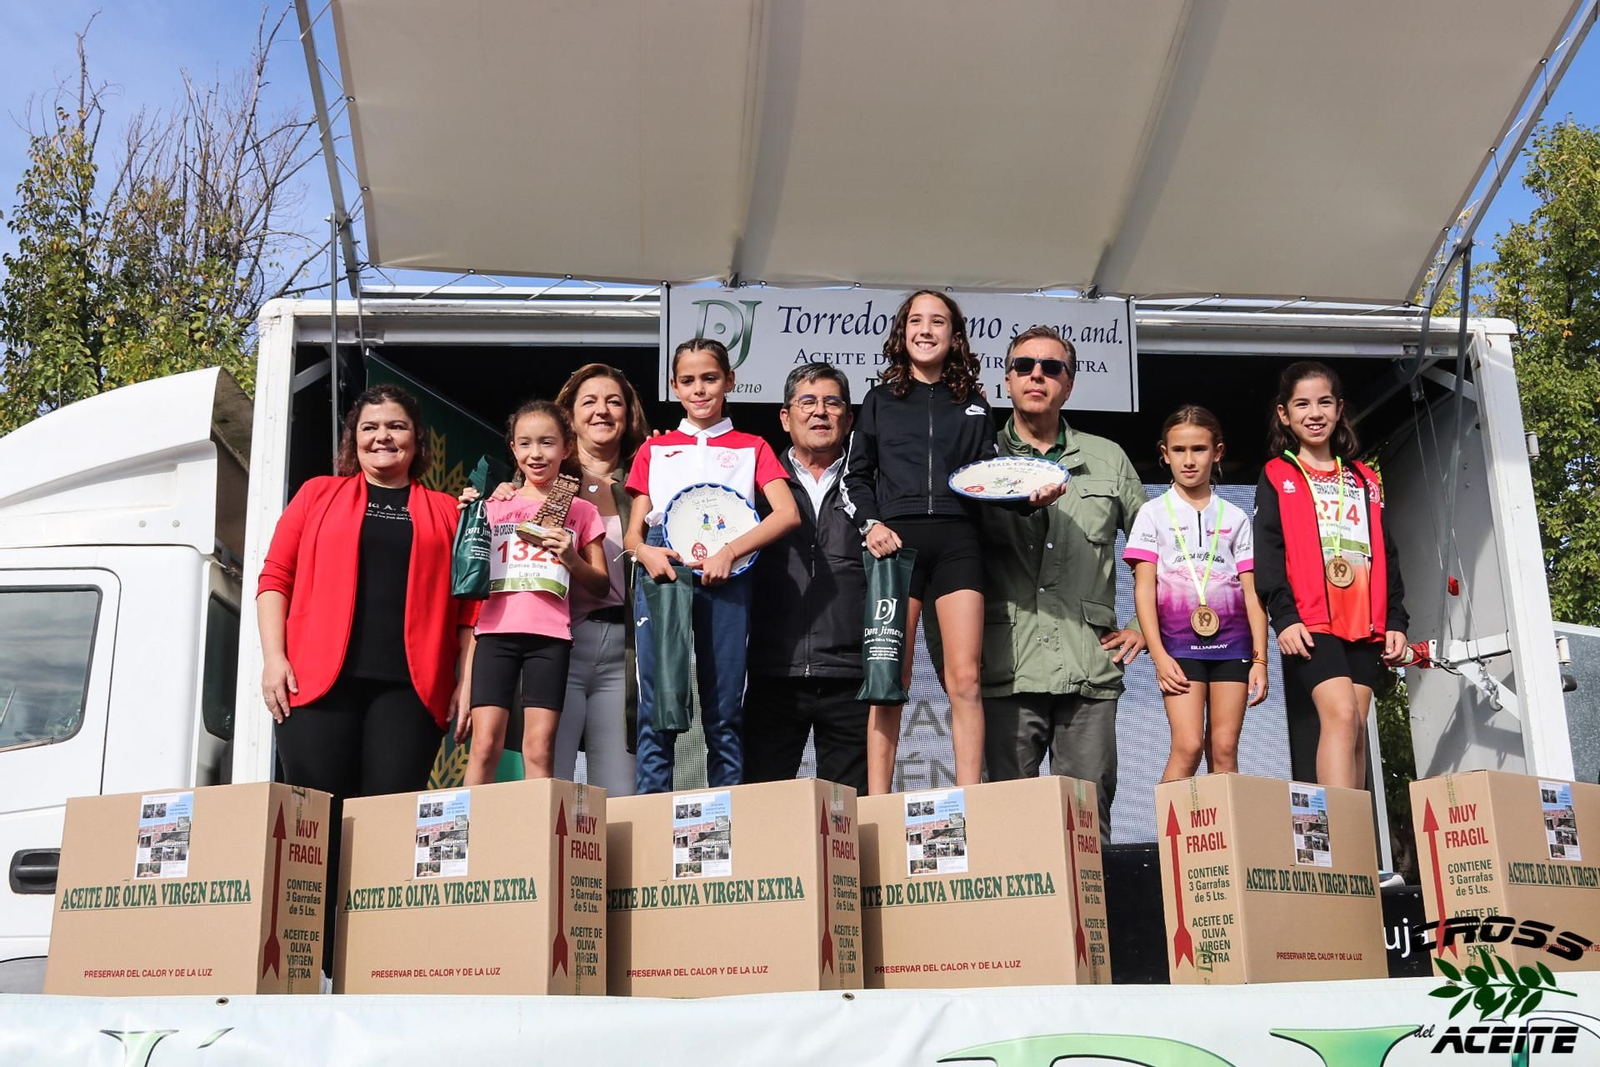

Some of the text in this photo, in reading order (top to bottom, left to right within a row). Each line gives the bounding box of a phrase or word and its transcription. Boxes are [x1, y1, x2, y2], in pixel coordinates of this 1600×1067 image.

[874, 598, 898, 624] DJ
[864, 628, 878, 637] Don
[1191, 808, 1216, 828] MUY
[1449, 804, 1476, 824] MUY
[296, 819, 319, 839] MUY
[576, 815, 597, 835] MUY
[1186, 832, 1227, 853] FRAGIL
[1445, 827, 1489, 848] FRAGIL
[289, 843, 322, 865] FRAGIL
[571, 840, 602, 861] FRAGIL
[832, 839, 856, 860] FRAGIL
[1188, 865, 1229, 879] CONTIENE
[1448, 860, 1492, 873] CONTIENE
[1450, 872, 1493, 885] 3 Garrafas
[1508, 862, 1598, 886] ACEITE DE OLIVA VIRGEN
[287, 879, 322, 892] CONTIENE
[570, 876, 602, 889] CONTIENE
[1189, 878, 1230, 891] 3 Garrafas
[1247, 867, 1375, 895] ACEITE DE OLIVA VIRGEN EXTRA
[61, 879, 251, 909] ACEITE DE OLIVA VIRGEN EXTRA
[345, 877, 537, 910] ACEITE DE OLIVA VIRGEN EXTRA
[571, 889, 602, 901] 3 Garrafas
[642, 886, 657, 908] DE
[662, 884, 699, 906] OLIVA
[703, 880, 754, 904] VIRGEN
[758, 876, 804, 901] EXTRA
[861, 886, 882, 907] ITE
[886, 884, 903, 905] DE
[907, 880, 946, 904] OLIVA
[950, 876, 1002, 901] VIRGEN
[1006, 872, 1055, 896] EXTRA
[1456, 885, 1490, 896] de 5 Lts.
[286, 892, 320, 904] 3 Garrafas
[1195, 891, 1227, 902] de 5 Lts.
[289, 904, 316, 916] de 5 Lts.
[574, 901, 599, 913] de 5 Lts.
[1192, 914, 1234, 927] ACEITE DE
[284, 929, 319, 941] ACEITE DE
[570, 927, 602, 938] ACEITE DE
[834, 925, 859, 936] ACEITE DE
[1202, 928, 1226, 938] OLIVA
[291, 942, 311, 953] OLIVA
[577, 940, 596, 950] OLIVA
[1199, 940, 1230, 951] VIRGEN
[1203, 953, 1230, 964] EXTRA
[84, 970, 125, 978] PRESERVAR
[127, 969, 140, 978] DEL
[288, 968, 310, 978] EXTRA
[371, 970, 412, 978] PRESERVAR
[627, 969, 672, 977] PRESERVAR
[691, 967, 717, 976] CALOR
[875, 965, 921, 974] PRESERVAR
